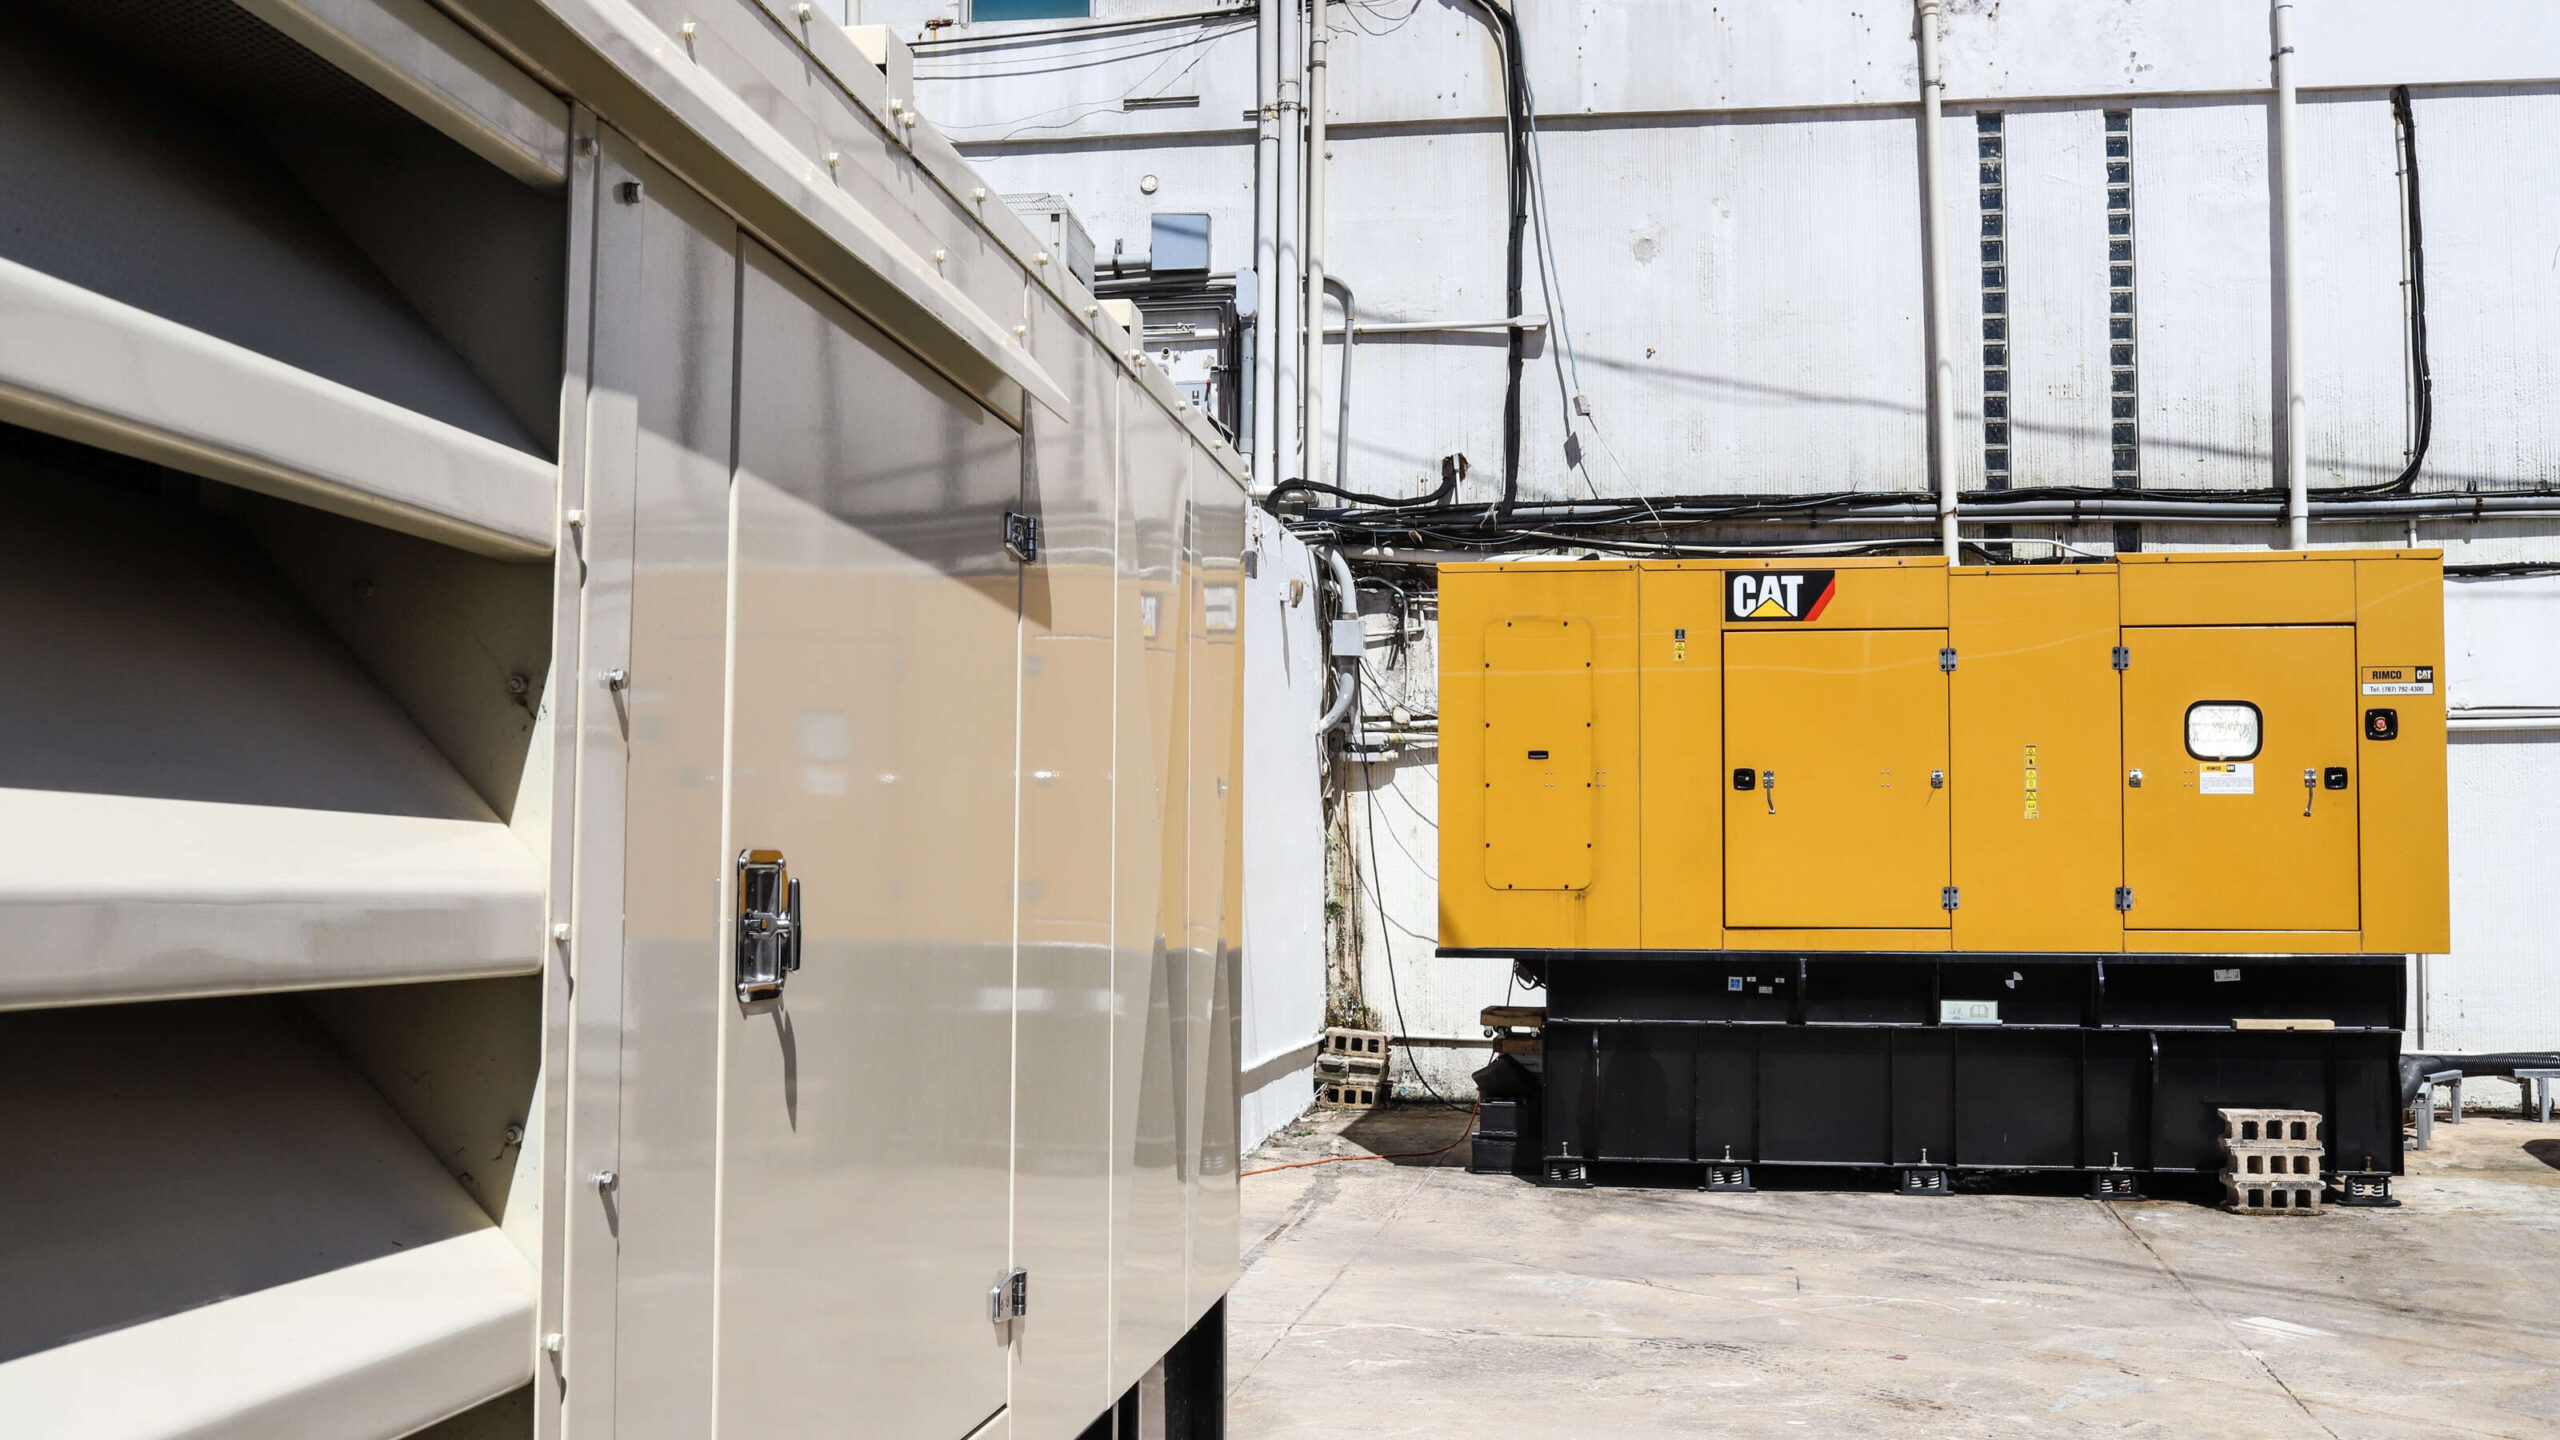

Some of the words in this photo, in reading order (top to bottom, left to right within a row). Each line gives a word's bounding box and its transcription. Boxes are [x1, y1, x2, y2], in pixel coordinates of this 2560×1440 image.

[1733, 574, 1804, 618] CAT
[2372, 670, 2402, 680] RIMCO
[2416, 669, 2432, 680] CAT
